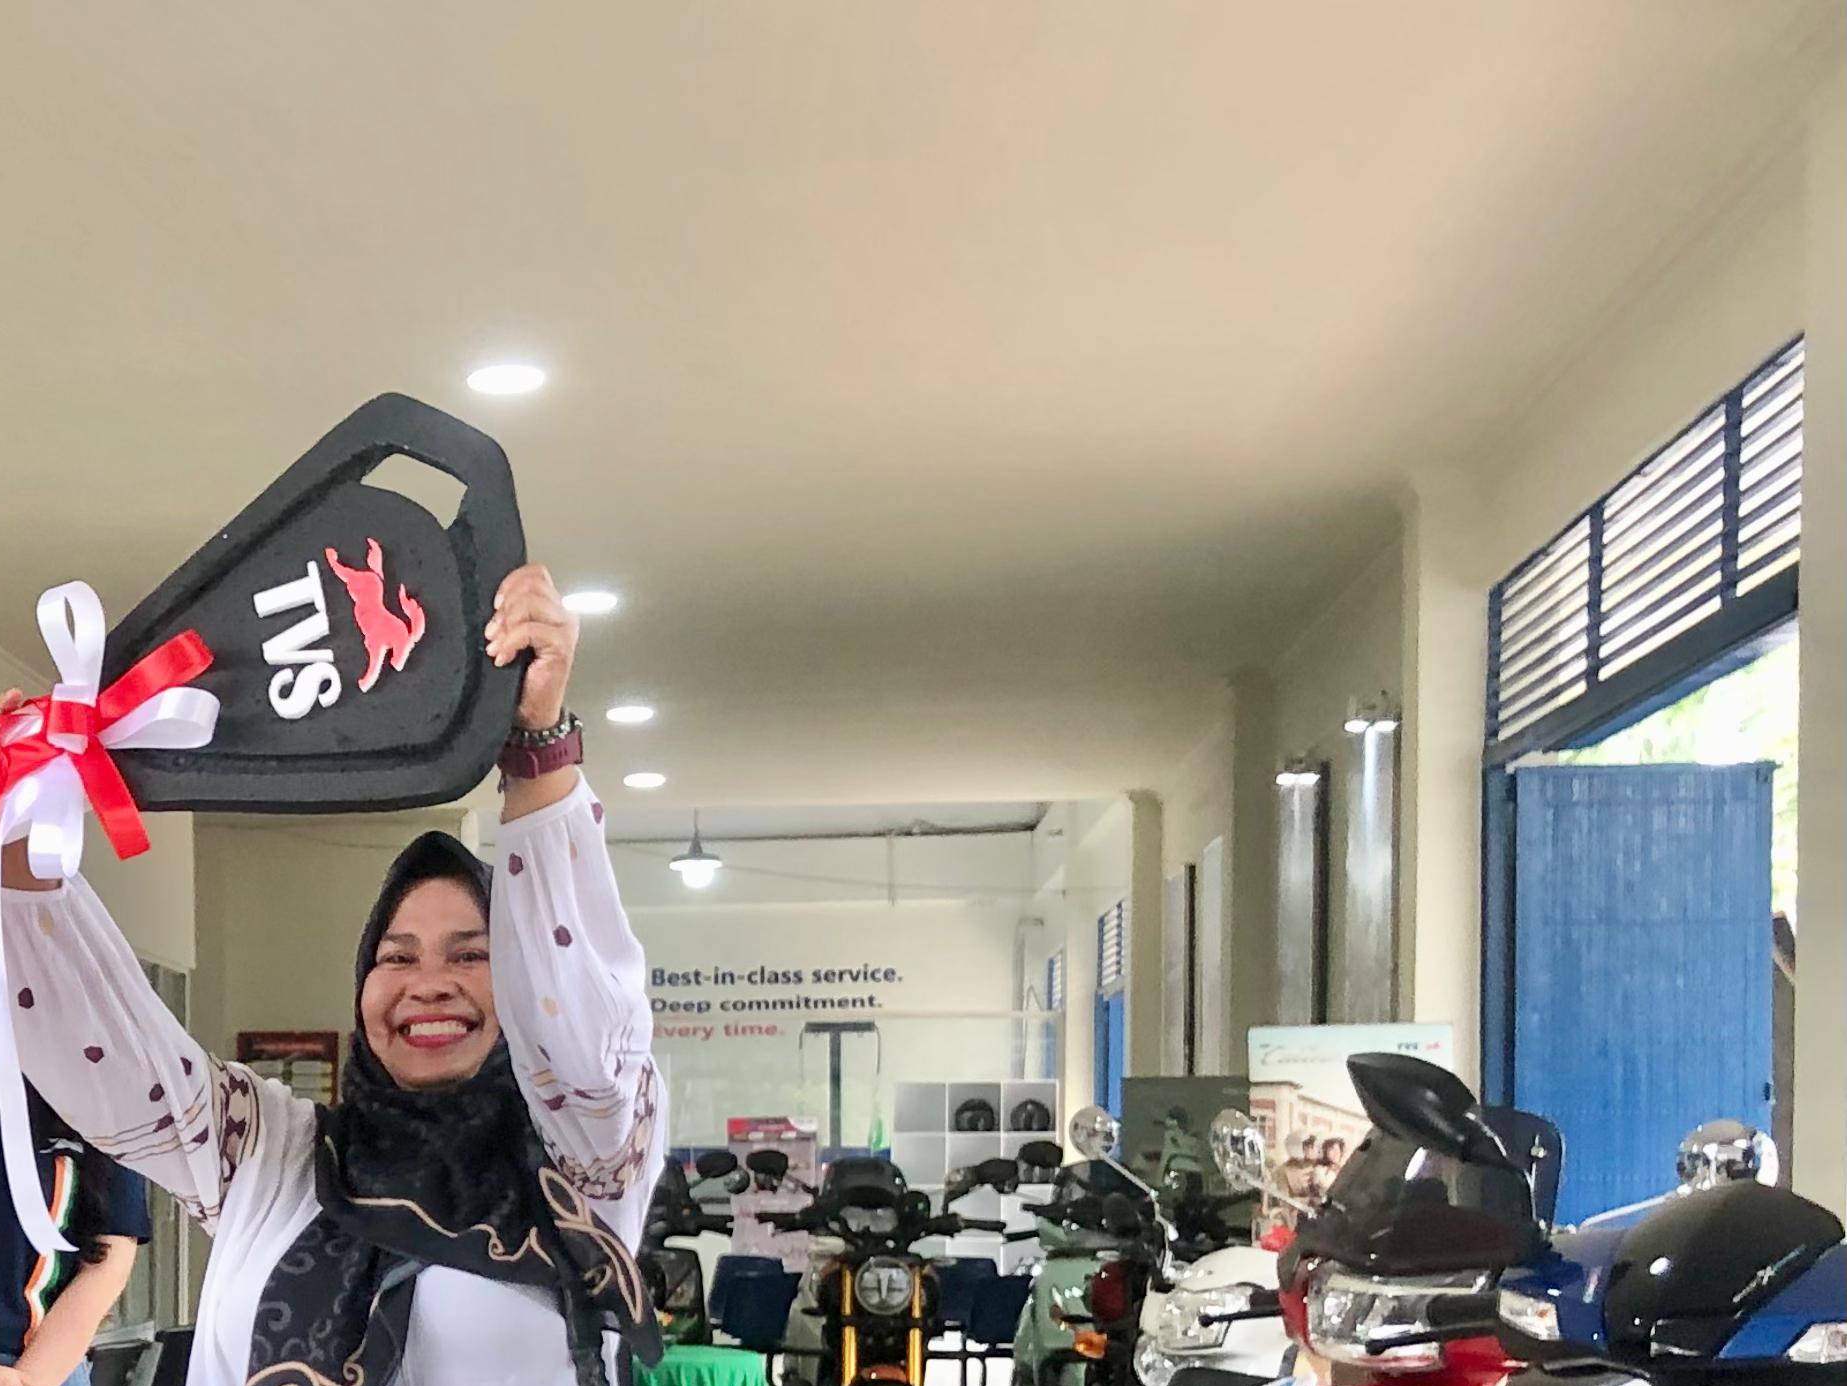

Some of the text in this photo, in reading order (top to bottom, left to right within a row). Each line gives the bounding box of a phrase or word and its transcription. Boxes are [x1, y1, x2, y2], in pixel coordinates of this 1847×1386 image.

[253, 560, 342, 720] TVS
[651, 962, 904, 987] Best-in-class service.
[650, 993, 883, 1014] Deep commitment.
[723, 1019, 784, 1038] time.
